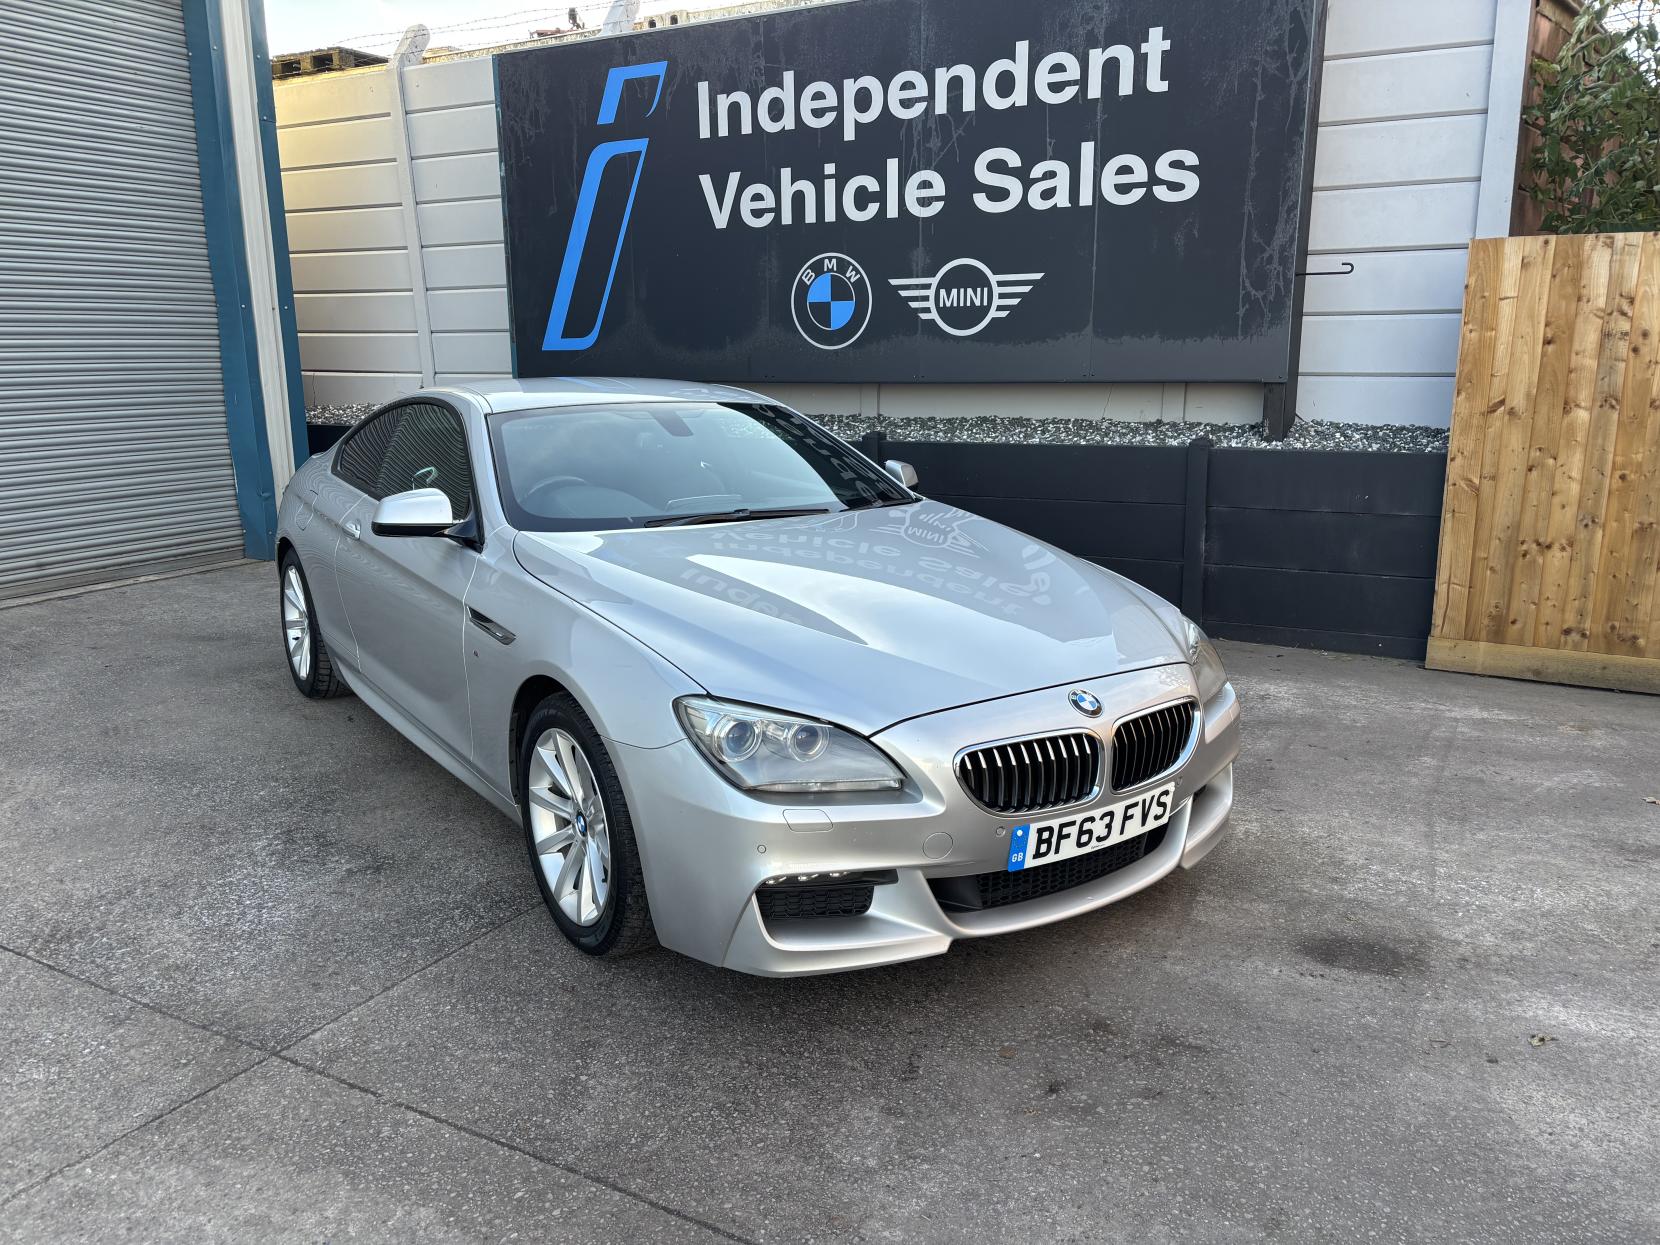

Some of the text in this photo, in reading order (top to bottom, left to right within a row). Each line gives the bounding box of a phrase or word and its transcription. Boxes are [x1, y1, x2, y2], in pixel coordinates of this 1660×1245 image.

[697, 26, 1171, 141] Independent
[699, 141, 1201, 229] Vehicle Sales
[801, 258, 861, 286] BMW
[939, 287, 988, 308] MINI
[1032, 789, 1170, 860] BF63 FVS
[1011, 852, 1024, 863] GB
